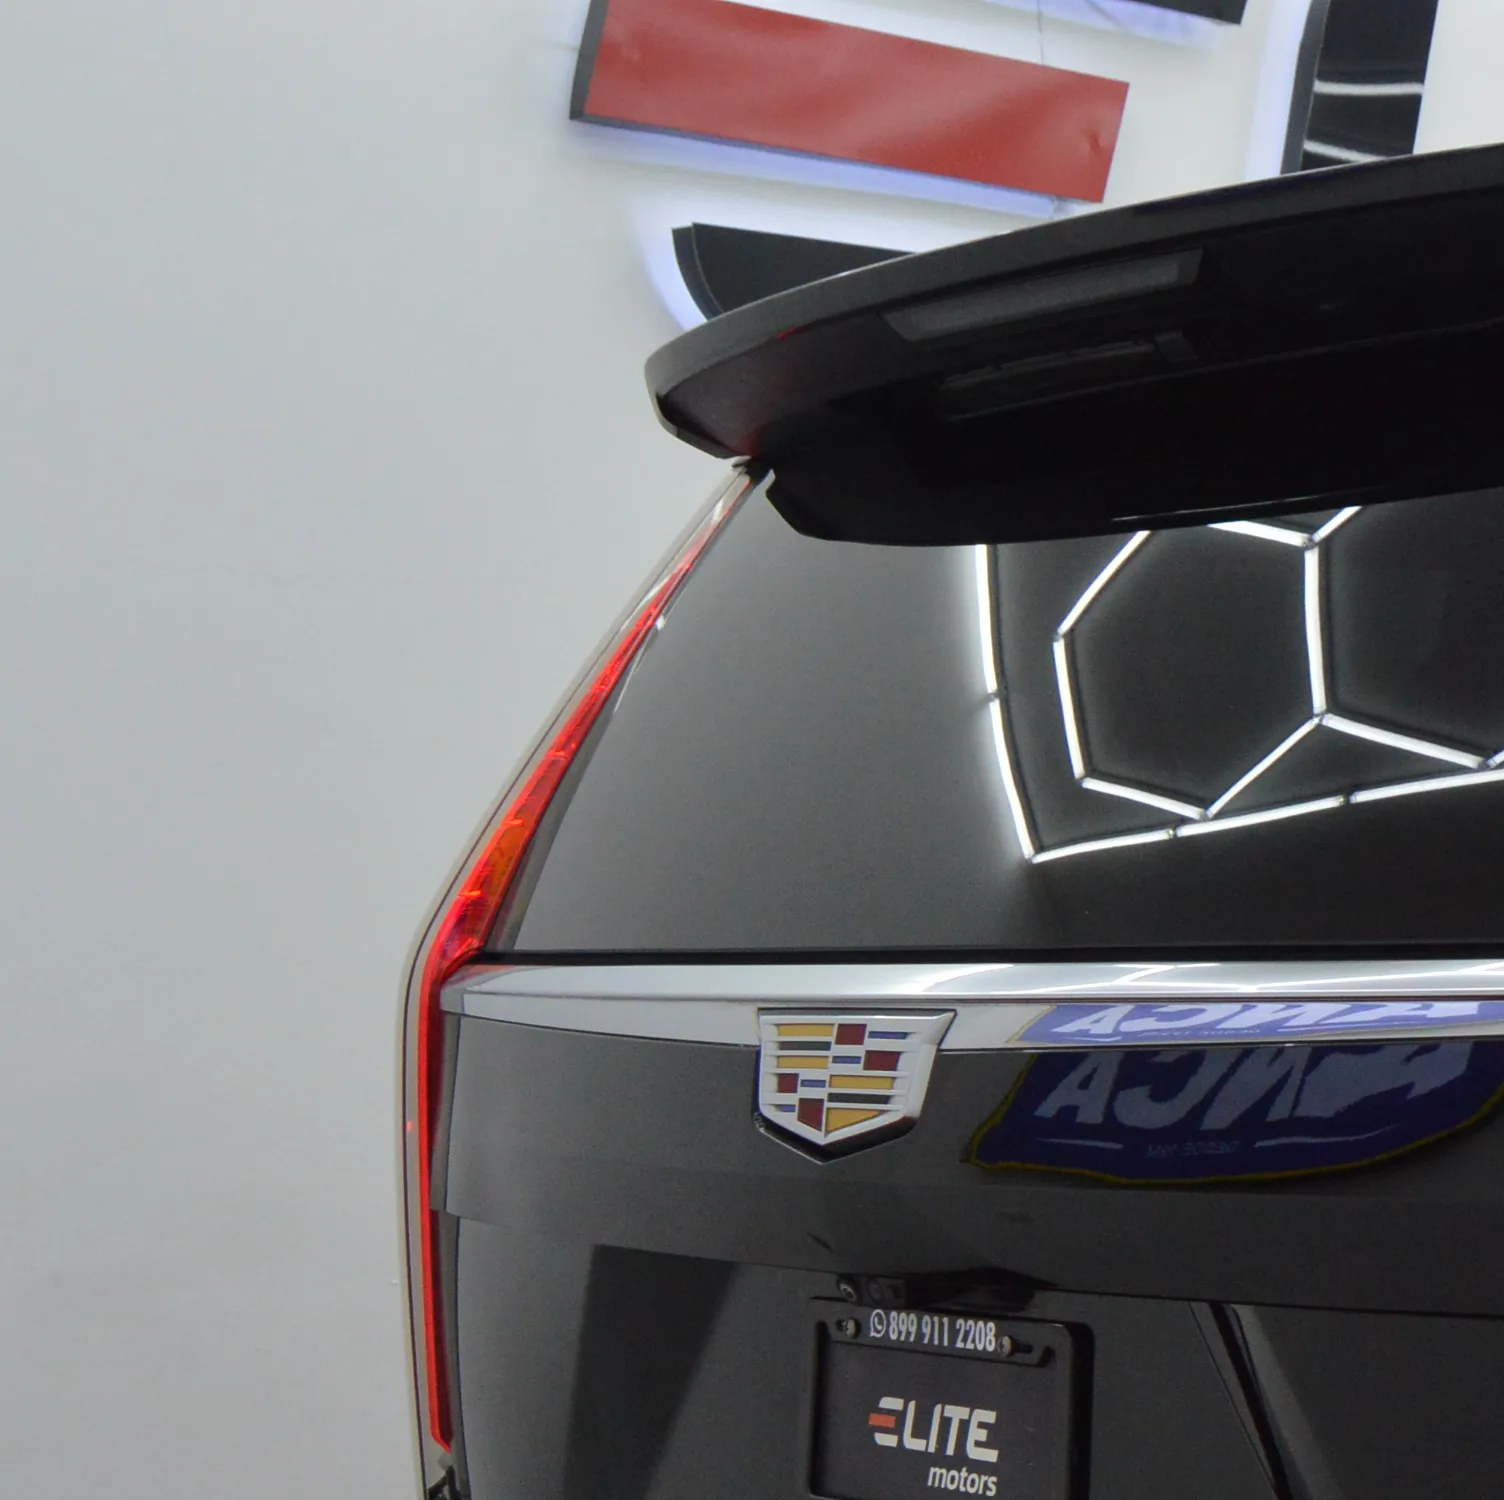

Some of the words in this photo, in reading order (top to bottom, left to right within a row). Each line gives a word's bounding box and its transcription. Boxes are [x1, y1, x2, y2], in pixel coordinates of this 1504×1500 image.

[888, 1311, 916, 1342] 899
[922, 1315, 949, 1346] 911
[956, 1319, 996, 1352] 2208
[868, 1396, 999, 1463] ELITE
[927, 1466, 998, 1497] motors
